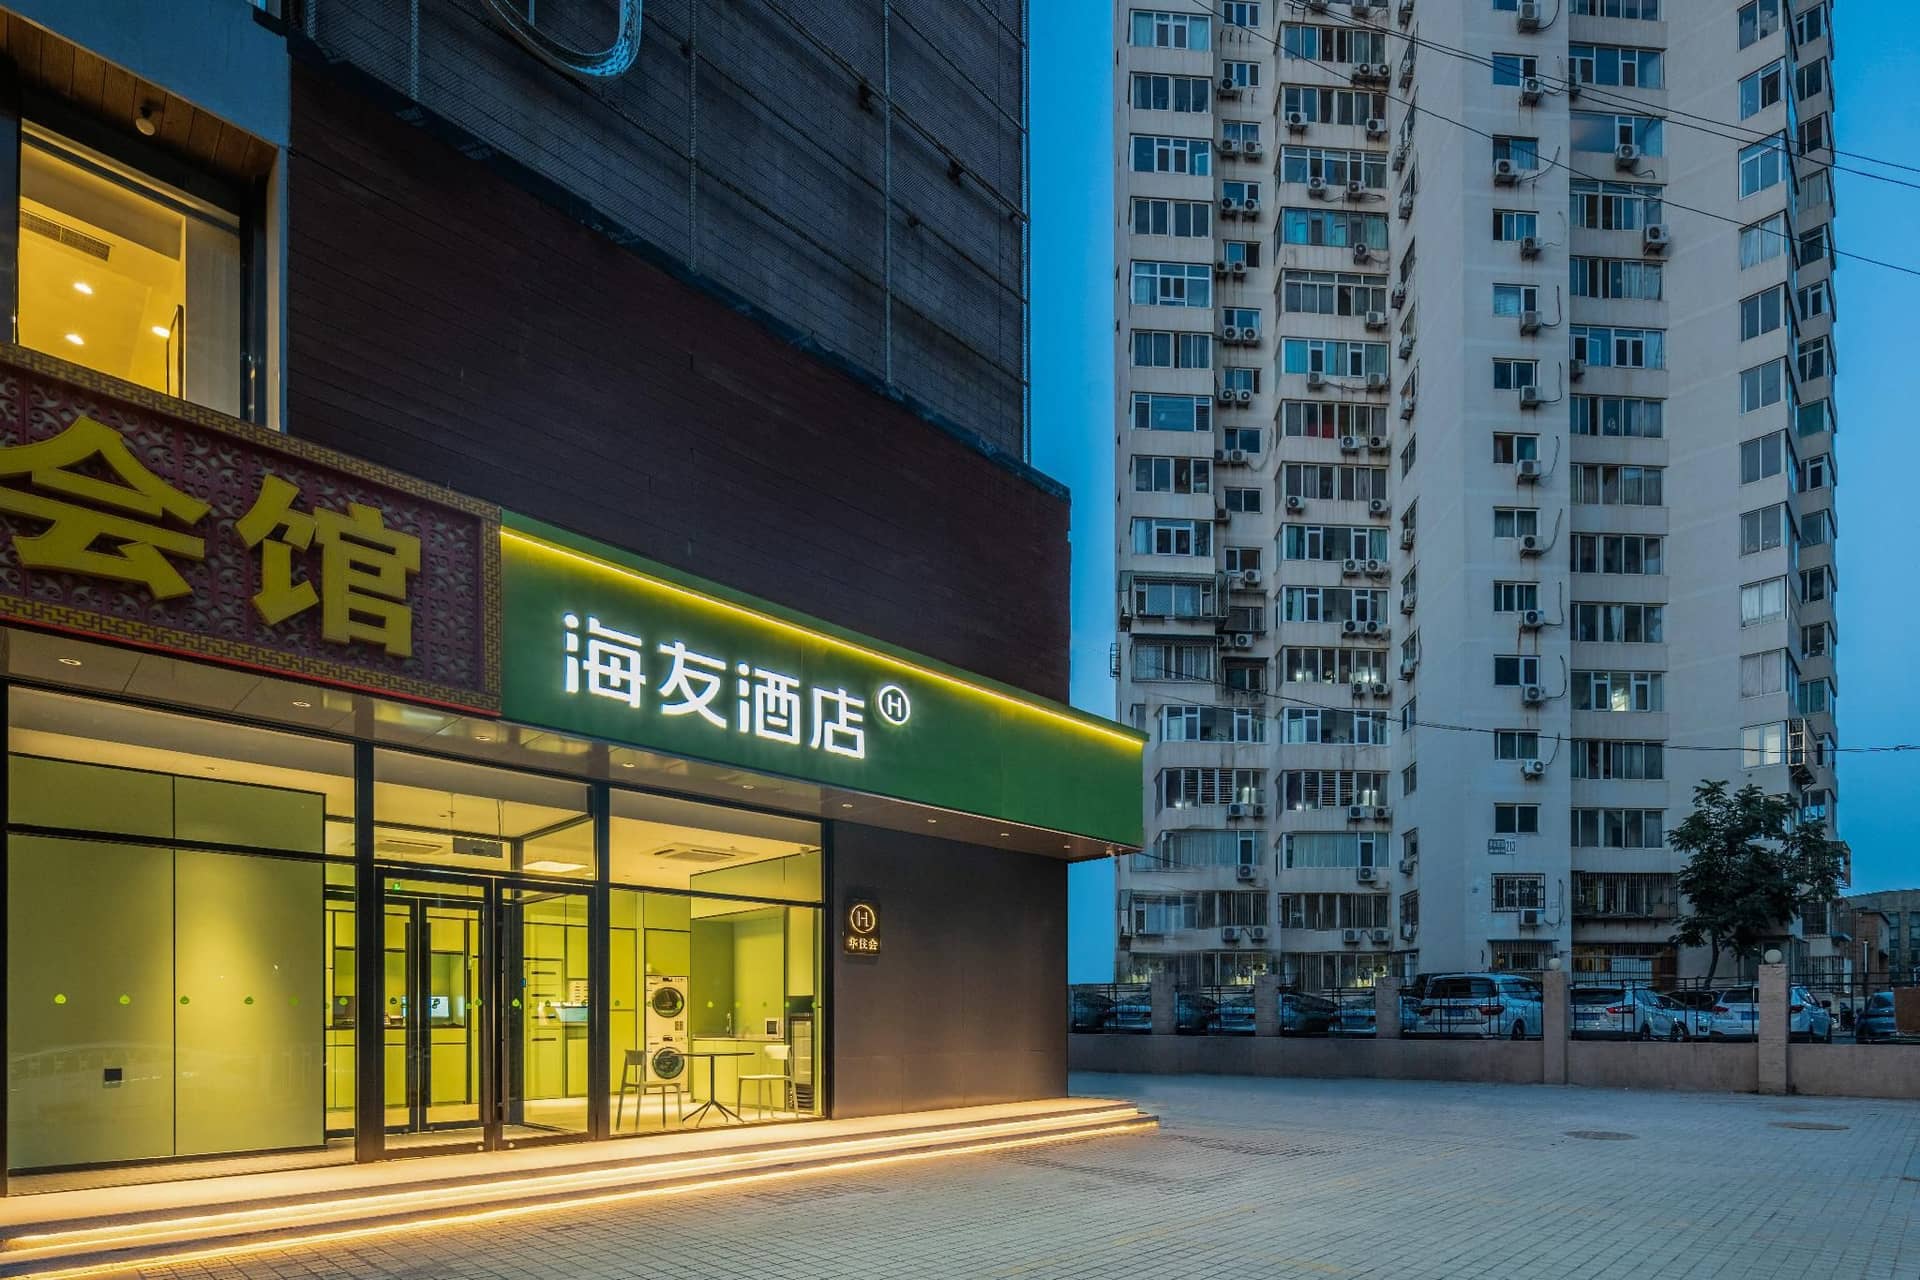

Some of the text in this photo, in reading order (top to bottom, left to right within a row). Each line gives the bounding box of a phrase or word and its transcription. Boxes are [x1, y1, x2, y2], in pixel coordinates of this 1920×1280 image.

[0, 415, 421, 657] 会馆
[563, 611, 866, 760] 海友酒店
